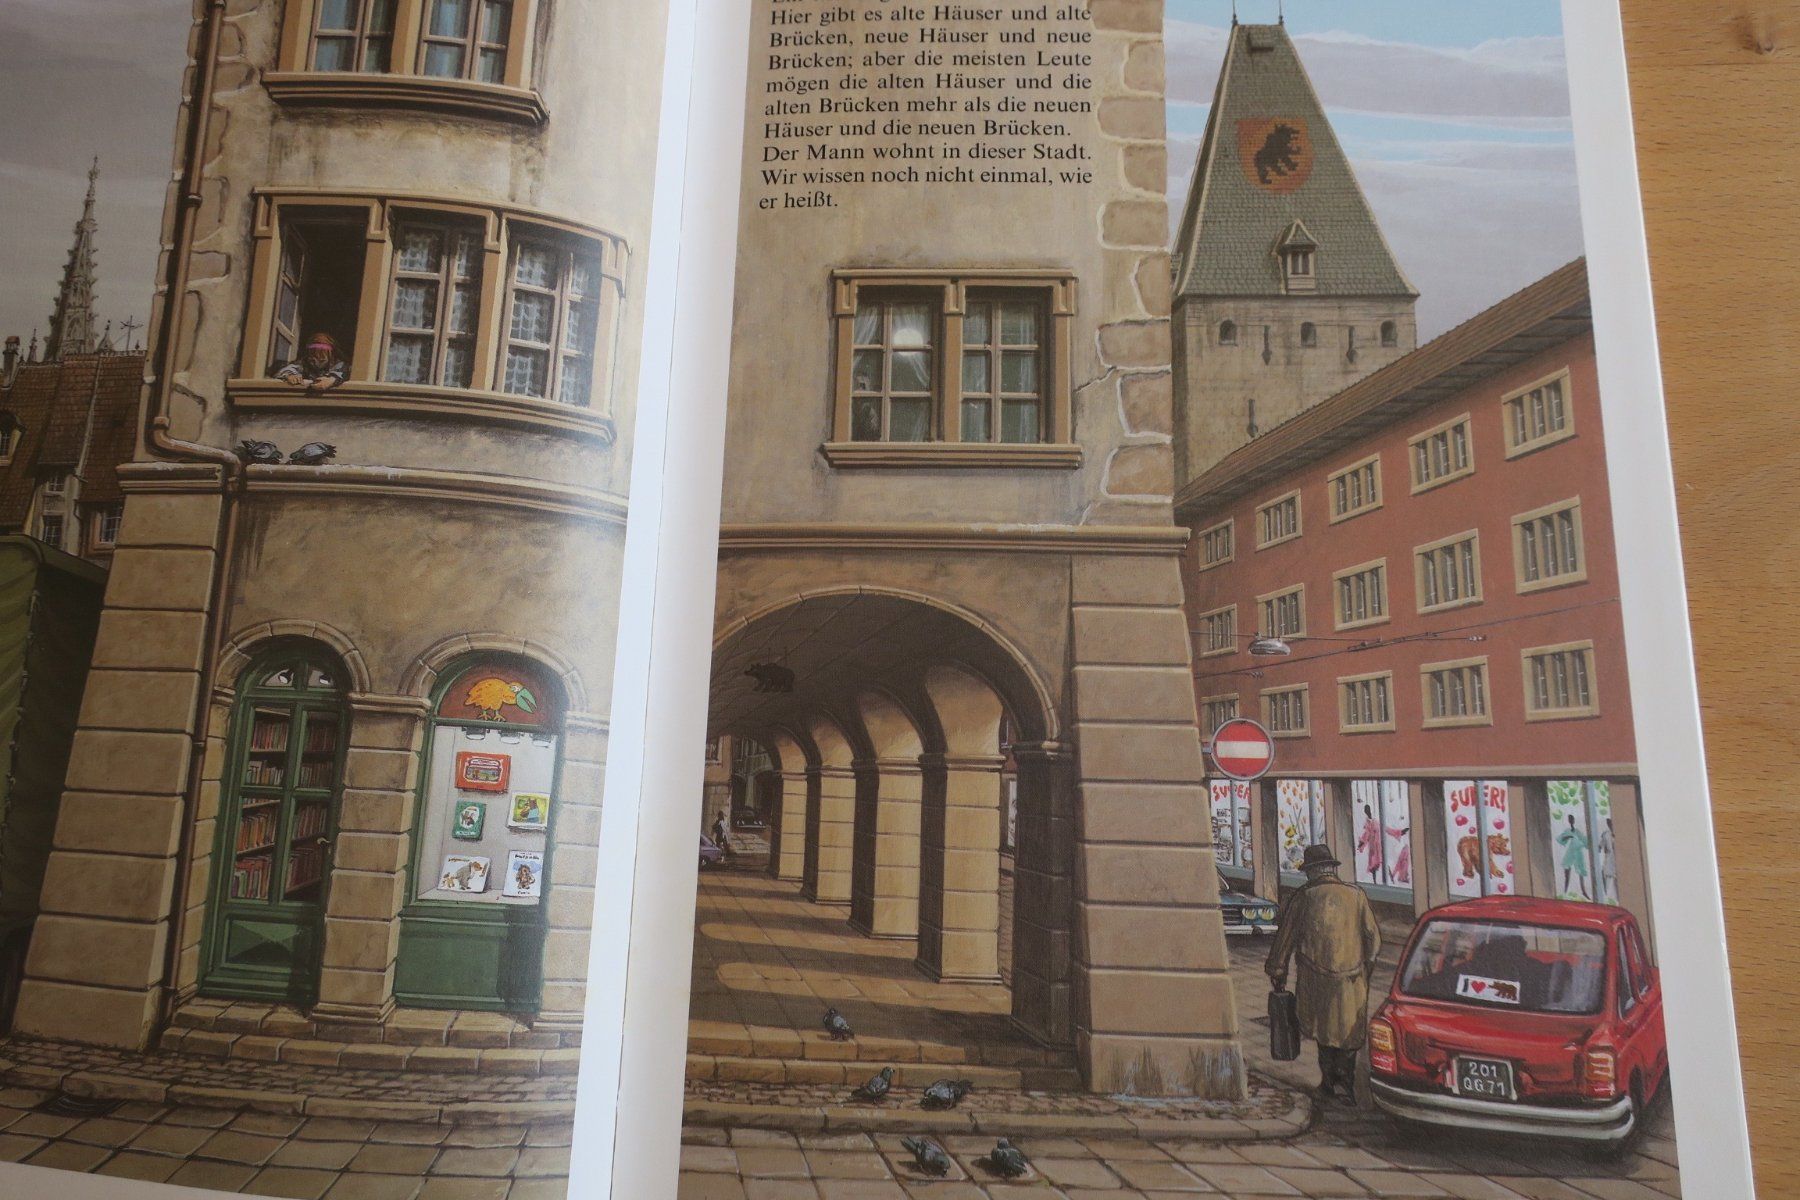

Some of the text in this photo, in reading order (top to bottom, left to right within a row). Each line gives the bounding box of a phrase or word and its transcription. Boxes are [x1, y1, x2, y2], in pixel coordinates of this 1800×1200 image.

[771, 3, 1091, 26] Hier gibt es alte Häuser und alte
[770, 28, 1091, 47] Brücken, neue Häuser und neue
[769, 50, 1091, 70] Brücken; aber die meisten Leute
[767, 73, 1091, 95] mögen die alten Häuser und die
[765, 96, 1091, 115] alten Brücken mehr als die neuen
[765, 119, 1070, 138] Häuser und die neuen Brücken.
[762, 142, 1091, 162] Der Mann wohnt in dieser Stadt.
[761, 166, 1092, 185] Wir wissen noch nicht einmal, wie
[759, 191, 837, 209] er heißt.
[1469, 1061, 1498, 1078] 201
